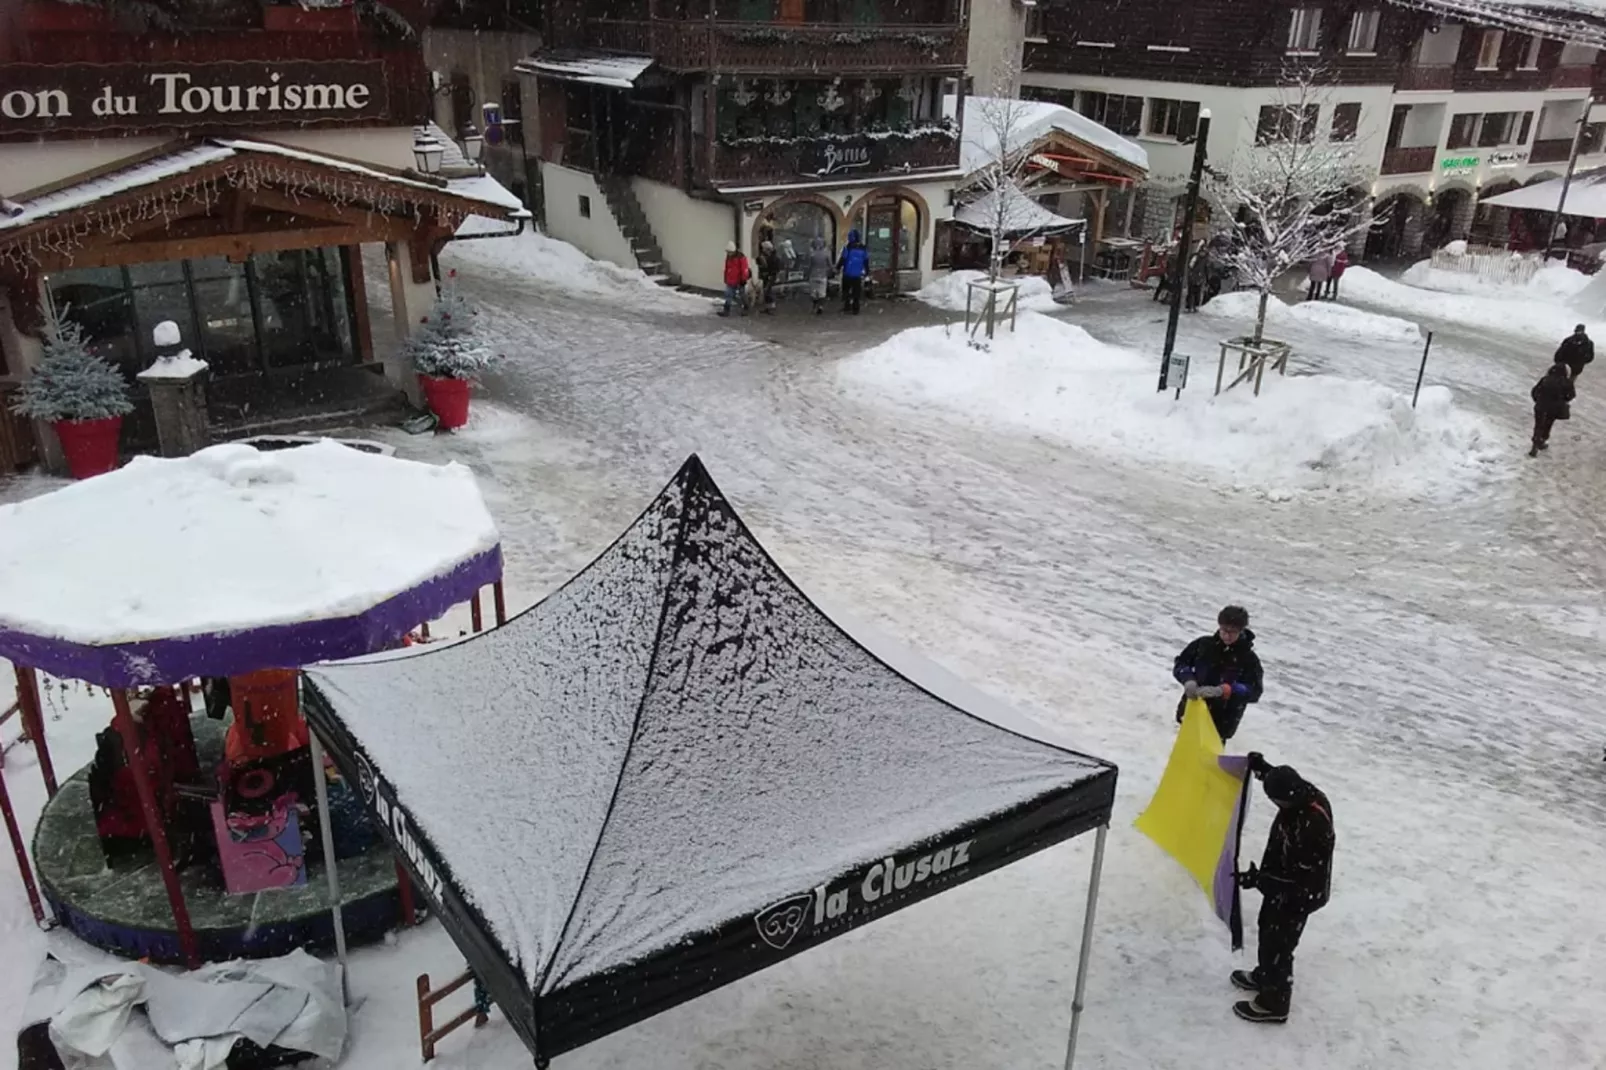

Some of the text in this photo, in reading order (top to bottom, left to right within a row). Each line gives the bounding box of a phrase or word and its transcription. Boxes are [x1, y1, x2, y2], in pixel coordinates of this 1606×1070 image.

[2, 72, 369, 118] on du Tourisme
[392, 806, 443, 905] Clusaz
[814, 839, 973, 925] la Clusaz
